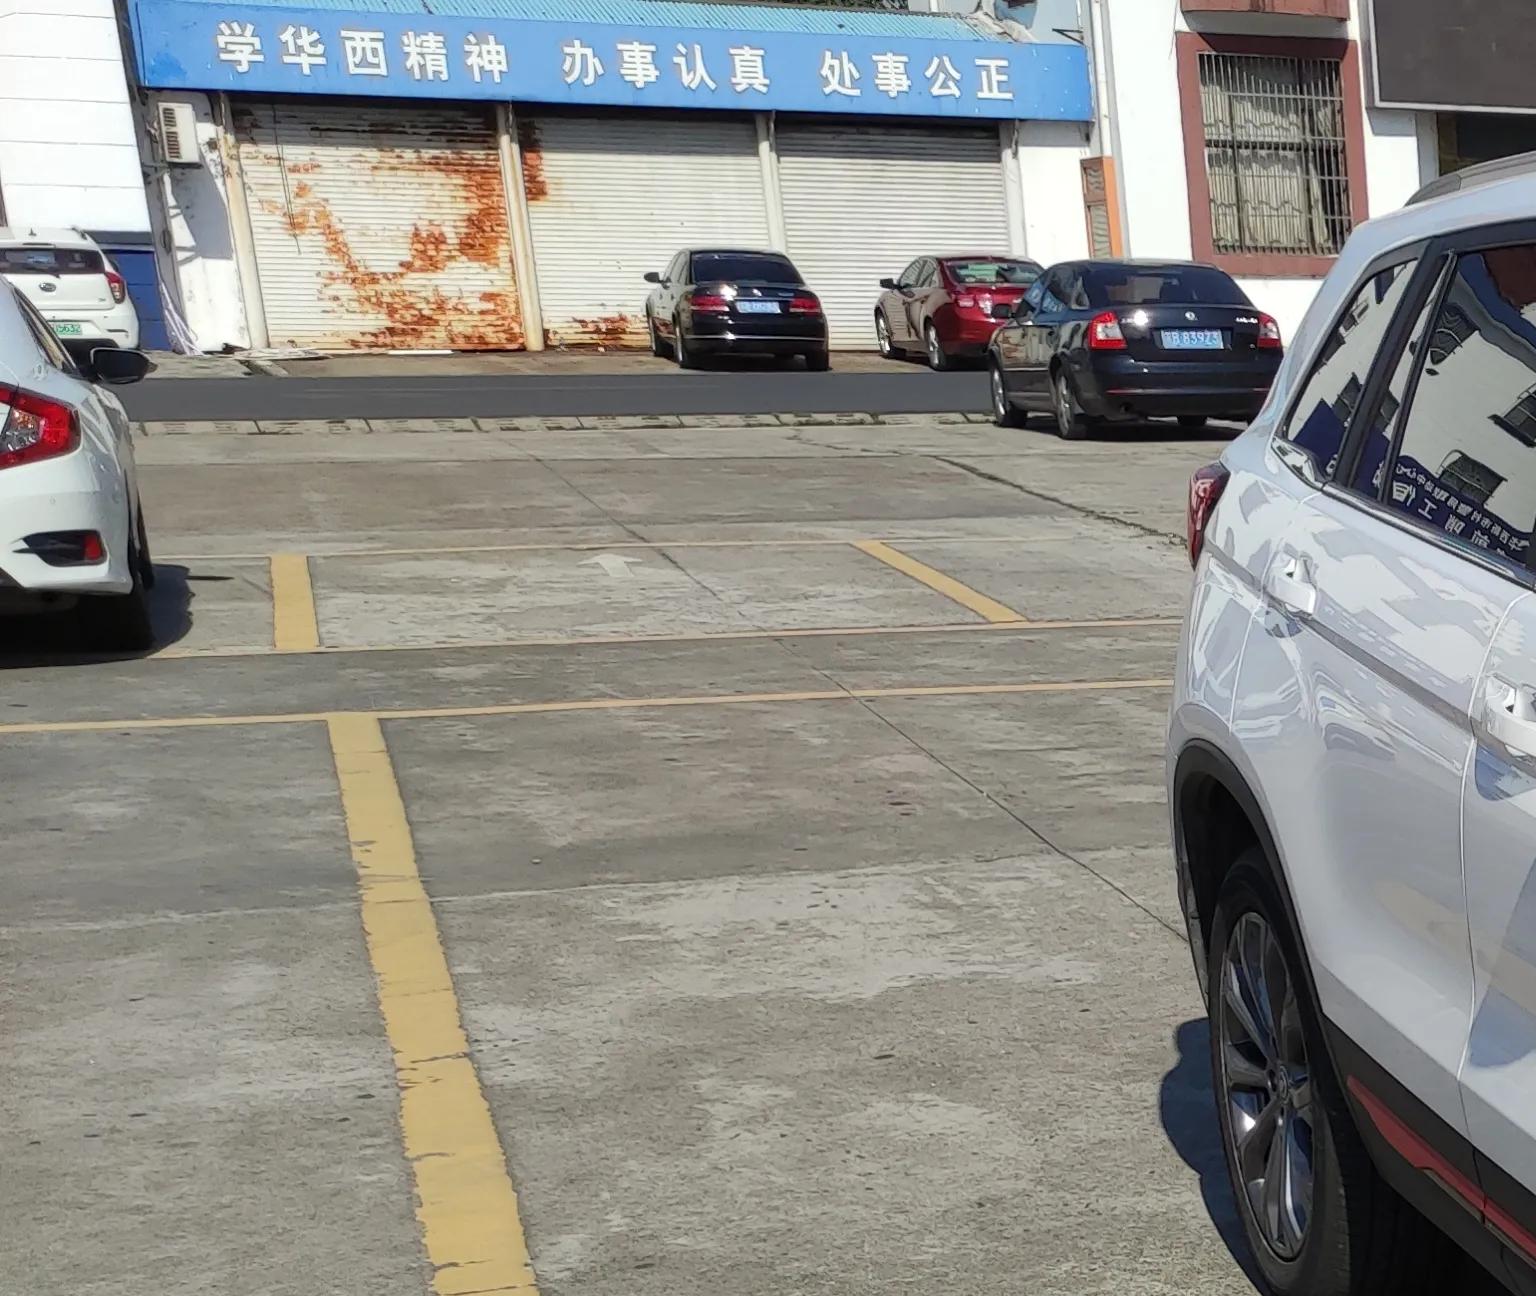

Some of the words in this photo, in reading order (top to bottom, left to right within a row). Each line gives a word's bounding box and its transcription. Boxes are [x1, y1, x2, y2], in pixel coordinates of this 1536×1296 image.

[216, 20, 509, 84] 学华西精神
[563, 39, 770, 94] 办事认真
[820, 50, 1014, 101] 处事公正
